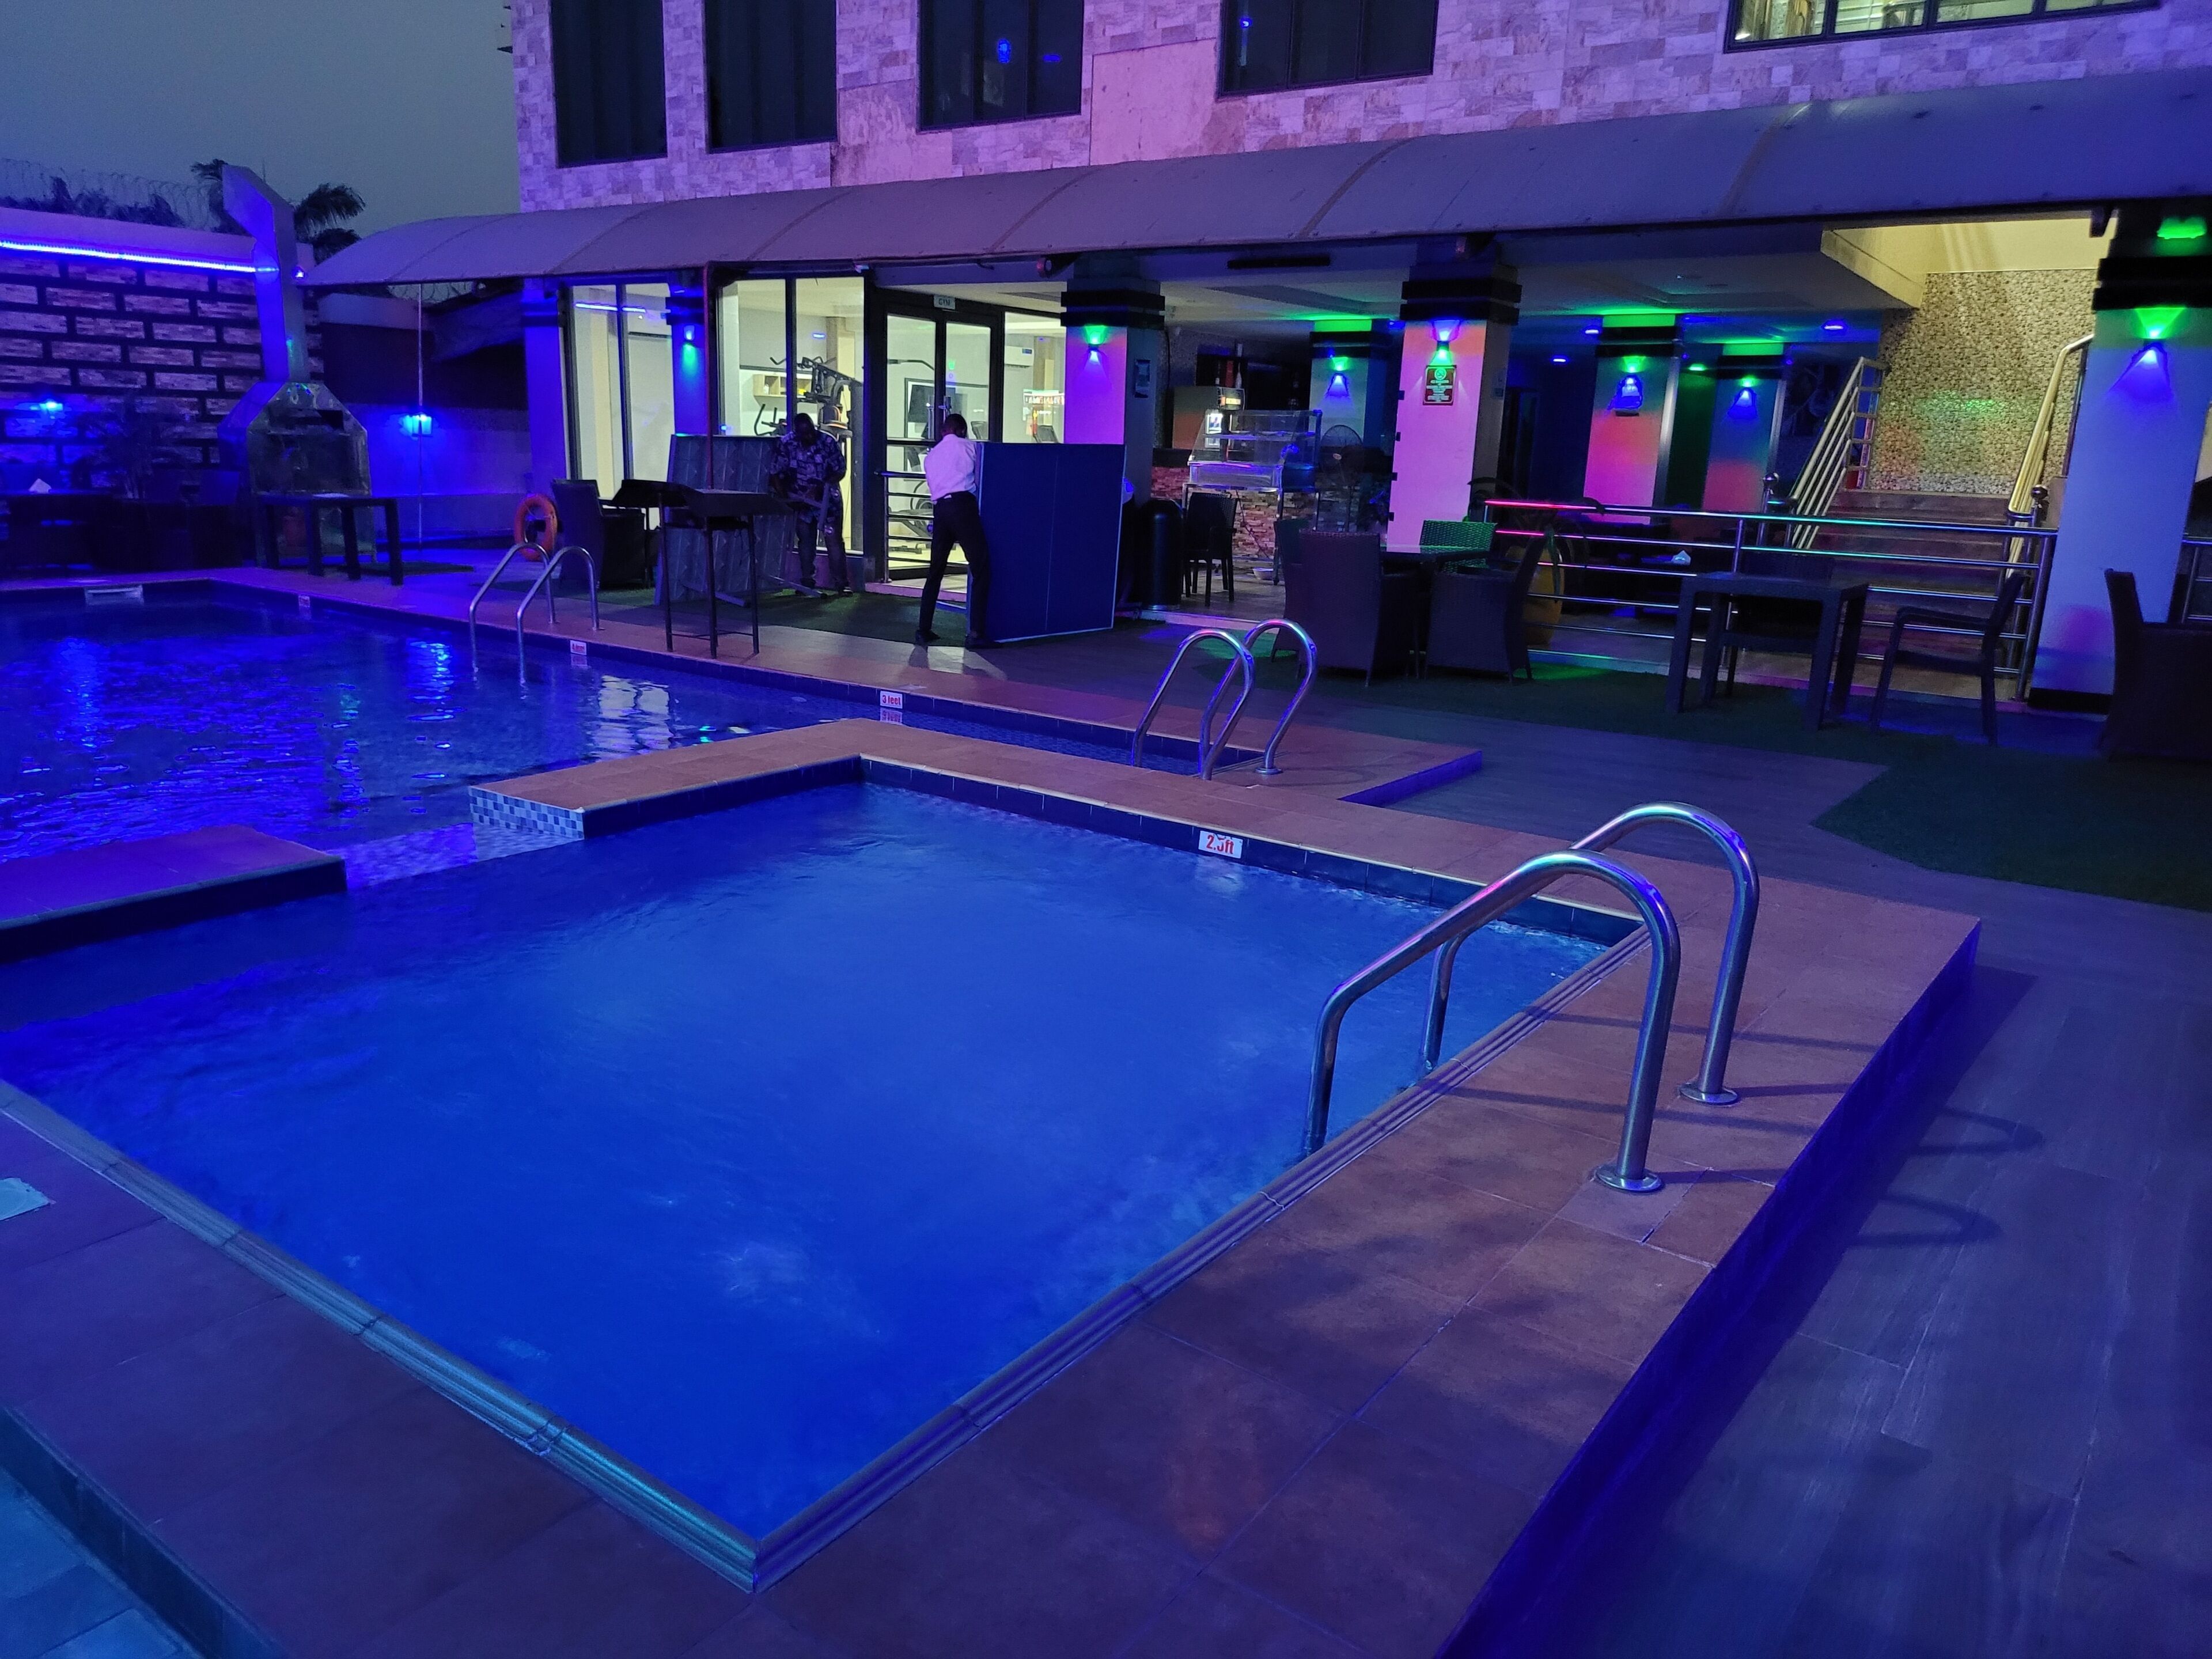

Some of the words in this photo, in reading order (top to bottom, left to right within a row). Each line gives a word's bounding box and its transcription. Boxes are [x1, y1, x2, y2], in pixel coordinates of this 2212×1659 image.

[939, 298, 950, 306] GYM
[882, 695, 887, 703] 3
[888, 695, 900, 706] feet
